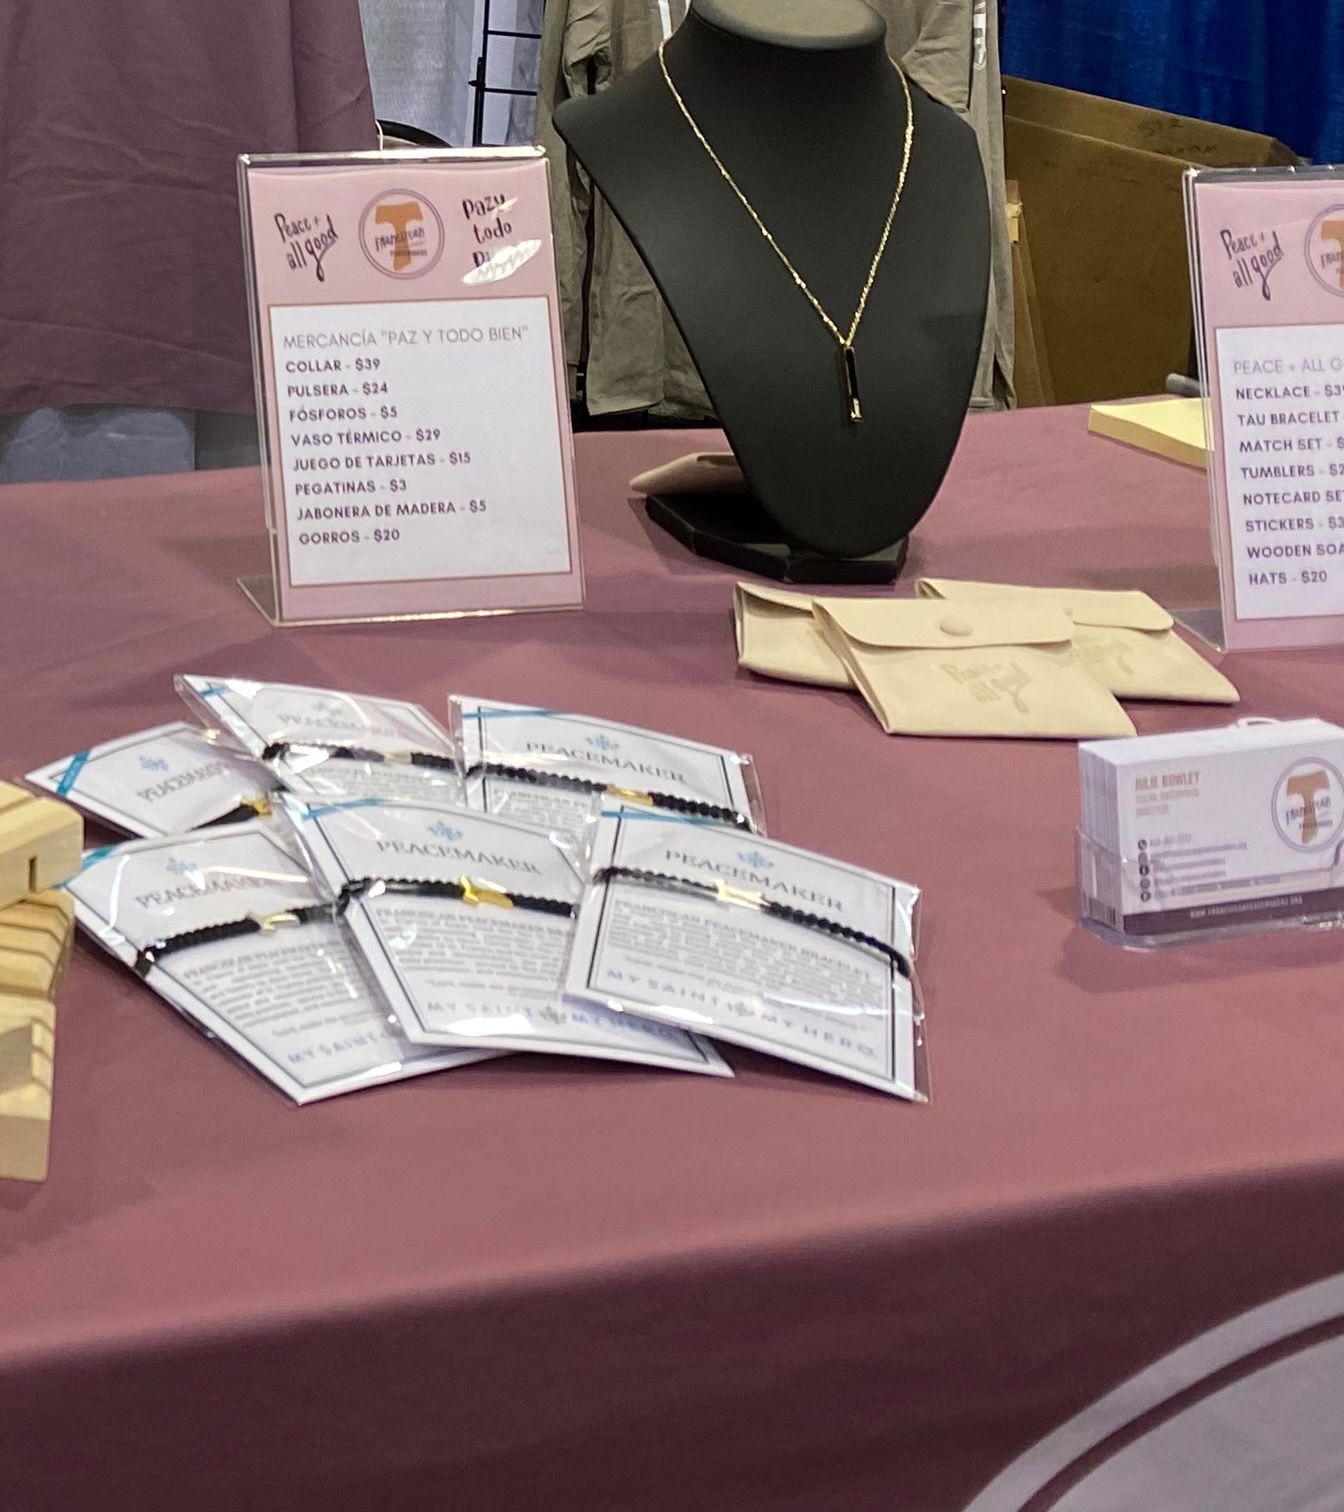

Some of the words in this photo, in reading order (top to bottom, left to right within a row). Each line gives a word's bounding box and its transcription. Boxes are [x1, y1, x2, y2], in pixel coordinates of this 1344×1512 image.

[274, 213, 312, 242] Peace
[286, 242, 307, 270] all
[305, 216, 338, 281] good
[1220, 229, 1258, 259] Peace
[1233, 258, 1253, 288] all
[1251, 230, 1284, 301] good
[283, 328, 377, 349] MERCANCÍA
[423, 330, 432, 344] Y
[439, 328, 483, 343] TODO
[286, 360, 341, 373] COLLAR
[355, 358, 381, 371] $39
[1234, 360, 1283, 375] PEACE
[1302, 358, 1325, 372] ALL
[287, 384, 349, 397] PULSERA
[362, 381, 388, 395] $24
[1236, 386, 1310, 400] NECKLACE
[289, 405, 366, 422] FÓSFOROS
[380, 406, 397, 419] $5
[1238, 414, 1265, 426] TAU
[1271, 411, 1339, 425] BRACELET
[291, 433, 333, 446] VASO
[337, 429, 402, 444] TÉRMICO
[416, 429, 440, 442] $29
[1240, 440, 1293, 452] MATCH
[1298, 438, 1322, 451] SET
[293, 457, 340, 471] JUEGO
[345, 456, 362, 469] DE
[368, 454, 436, 468] TARJETAS
[449, 452, 471, 465] $15
[1241, 465, 1314, 479] TUMBLERS
[295, 481, 376, 496] PEGATINAS
[390, 479, 407, 492] $3
[1243, 492, 1320, 505] NOTECARD
[297, 505, 370, 521] JABONERA
[375, 504, 391, 517] DE
[396, 501, 456, 516] MADERA
[469, 500, 486, 513] $5
[1246, 518, 1313, 532] STICKERS
[299, 531, 360, 545] GORROS
[373, 529, 400, 542] $20
[1247, 545, 1312, 558] WOODEN
[1317, 544, 1344, 556] SOA
[1249, 572, 1287, 585] HATS
[1302, 571, 1327, 583] $20
[526, 742, 685, 783] PEACEMAKER
[376, 840, 542, 876] PEACEMAKER
[666, 849, 844, 912] PEACEMAKER
